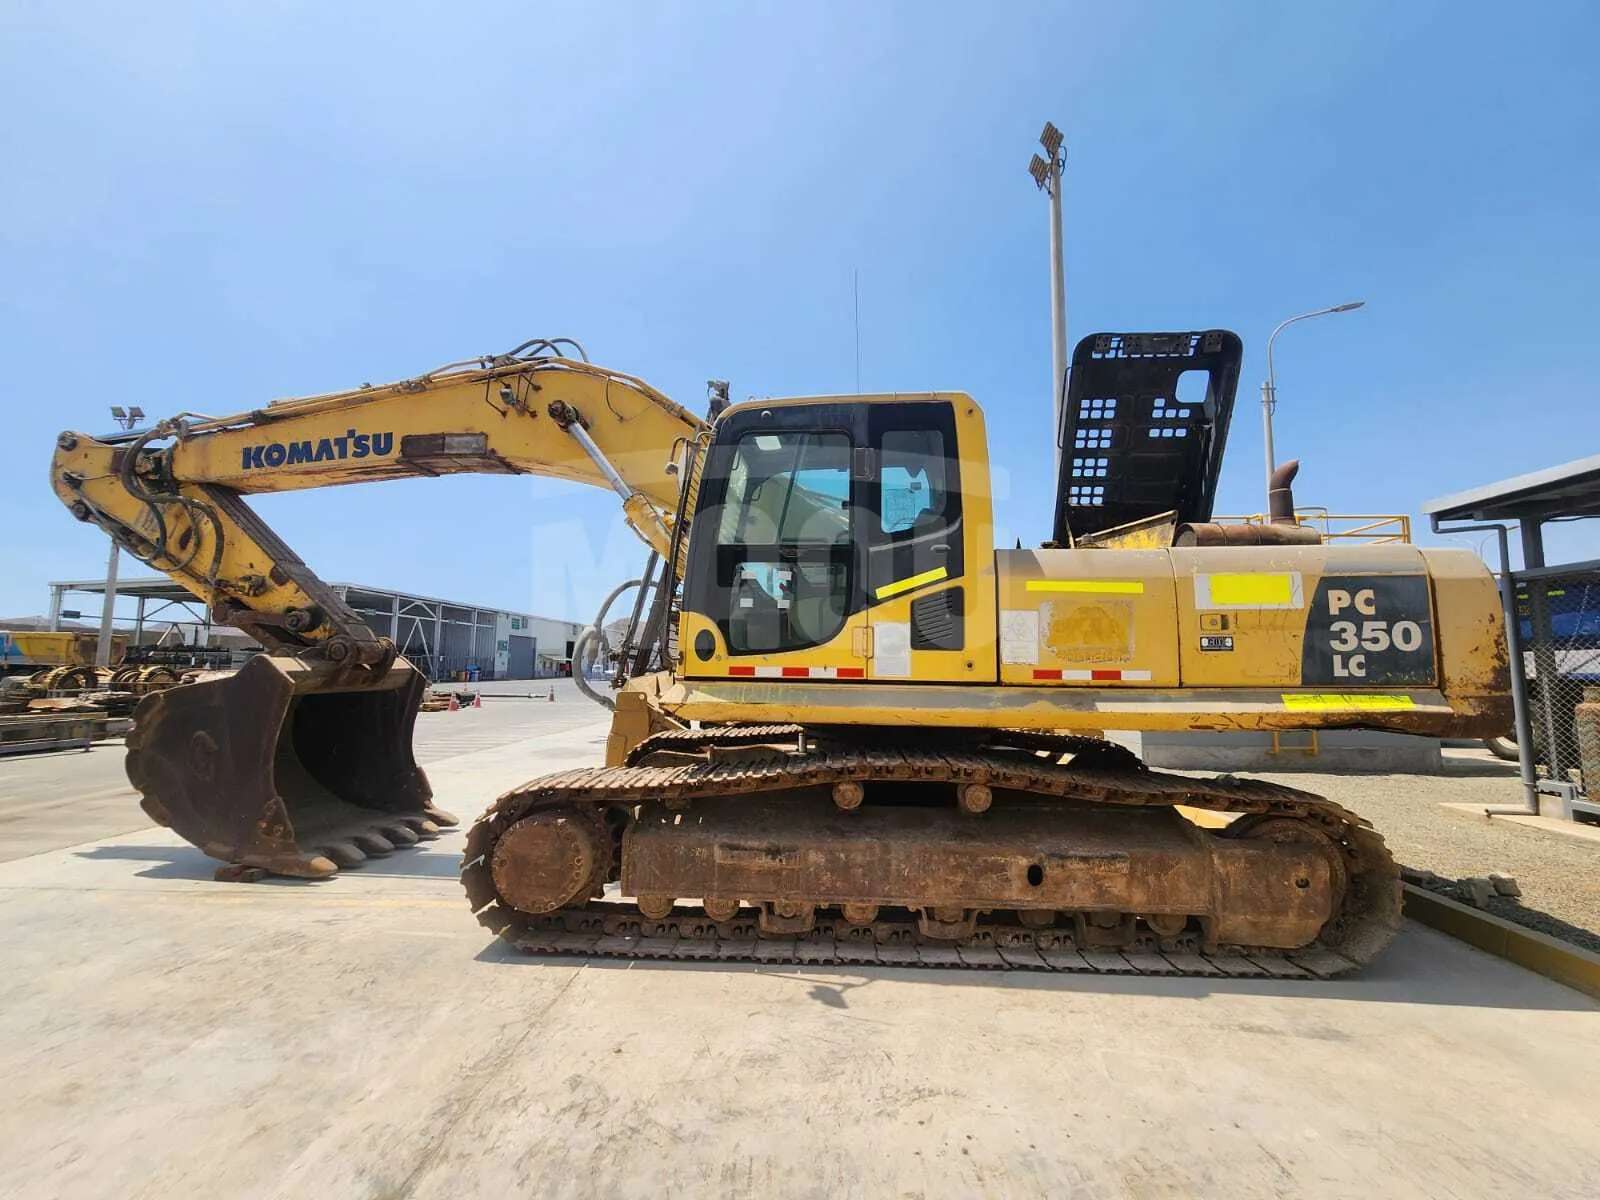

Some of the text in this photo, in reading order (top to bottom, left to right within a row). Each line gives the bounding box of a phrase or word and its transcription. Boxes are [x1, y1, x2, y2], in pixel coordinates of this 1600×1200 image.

[242, 428, 393, 469] KOMATSU
[1327, 588, 1376, 616] PC
[1329, 620, 1422, 652] 350
[1332, 654, 1367, 677] LC
